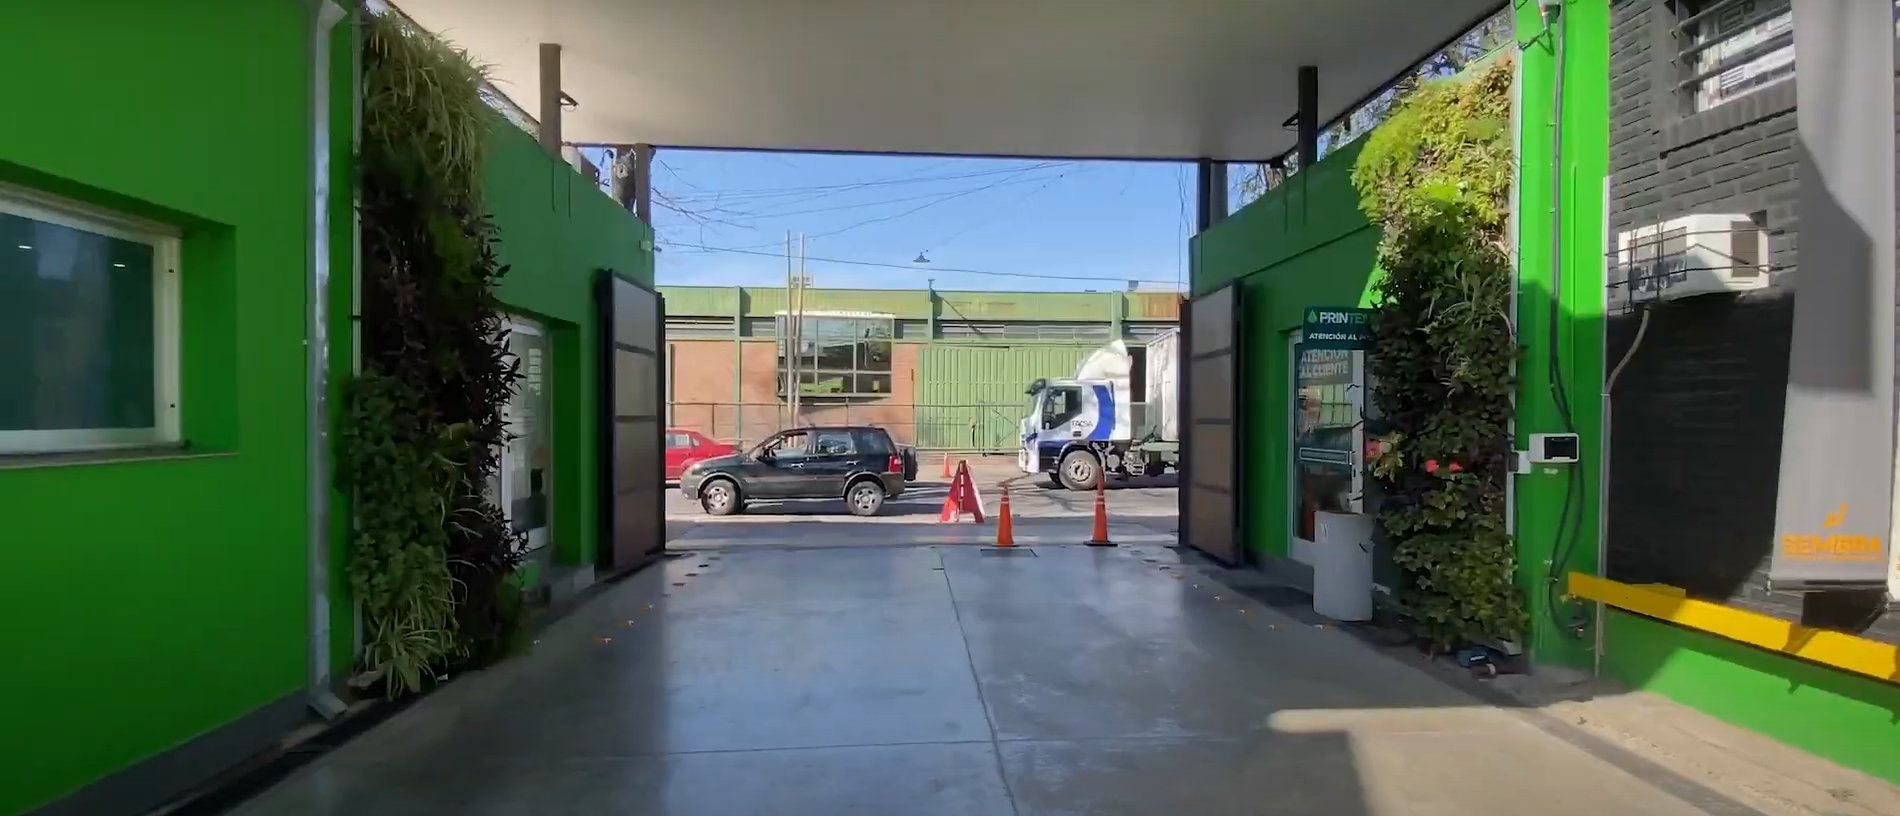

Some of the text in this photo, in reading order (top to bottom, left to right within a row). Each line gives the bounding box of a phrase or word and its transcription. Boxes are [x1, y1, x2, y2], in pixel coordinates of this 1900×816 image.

[1308, 331, 1347, 341] ATENCIÓN
[1347, 333, 1358, 341] AL
[1299, 360, 1348, 378] AL CLIENTE
[1781, 534, 1882, 554] SEMBRA
